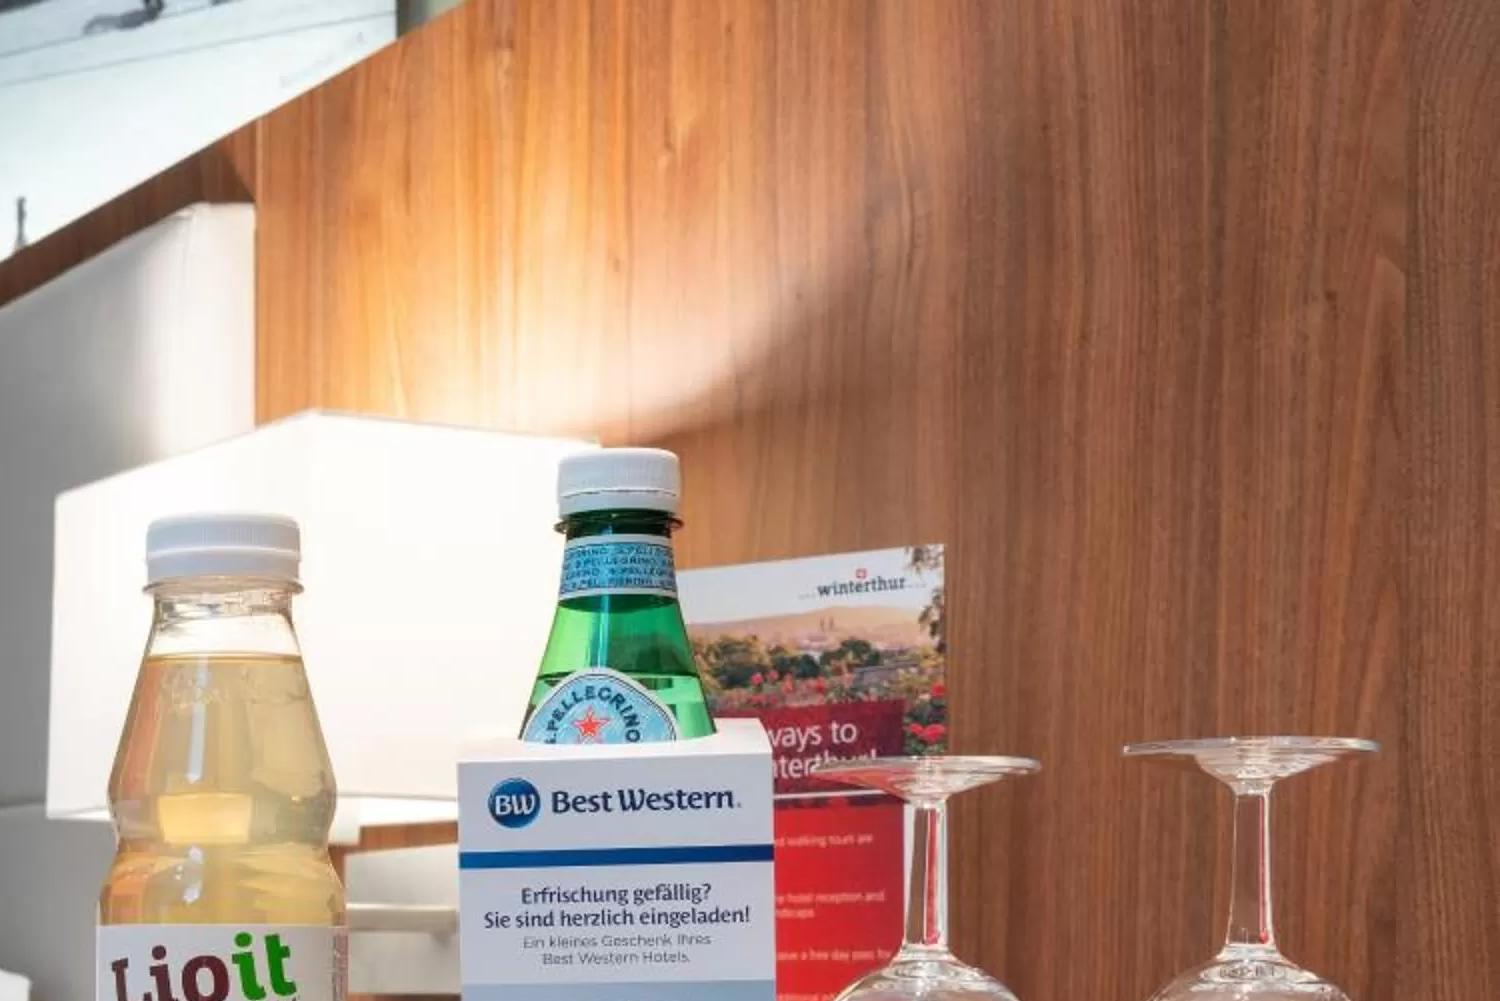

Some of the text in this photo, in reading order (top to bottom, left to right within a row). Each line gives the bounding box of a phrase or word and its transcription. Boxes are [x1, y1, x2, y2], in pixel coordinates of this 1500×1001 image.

[817, 576, 906, 597] winterthur
[830, 720, 858, 745] to
[495, 794, 536, 815] BW
[551, 790, 612, 814] Best
[521, 883, 711, 906] Erfrischung gefällig?
[484, 905, 750, 928] Sie sind herzlich eingeladen!
[523, 935, 545, 948] Ein
[549, 935, 599, 948] kleines
[601, 933, 672, 948] Geschenk
[542, 952, 573, 965] Best
[579, 951, 639, 965] Western
